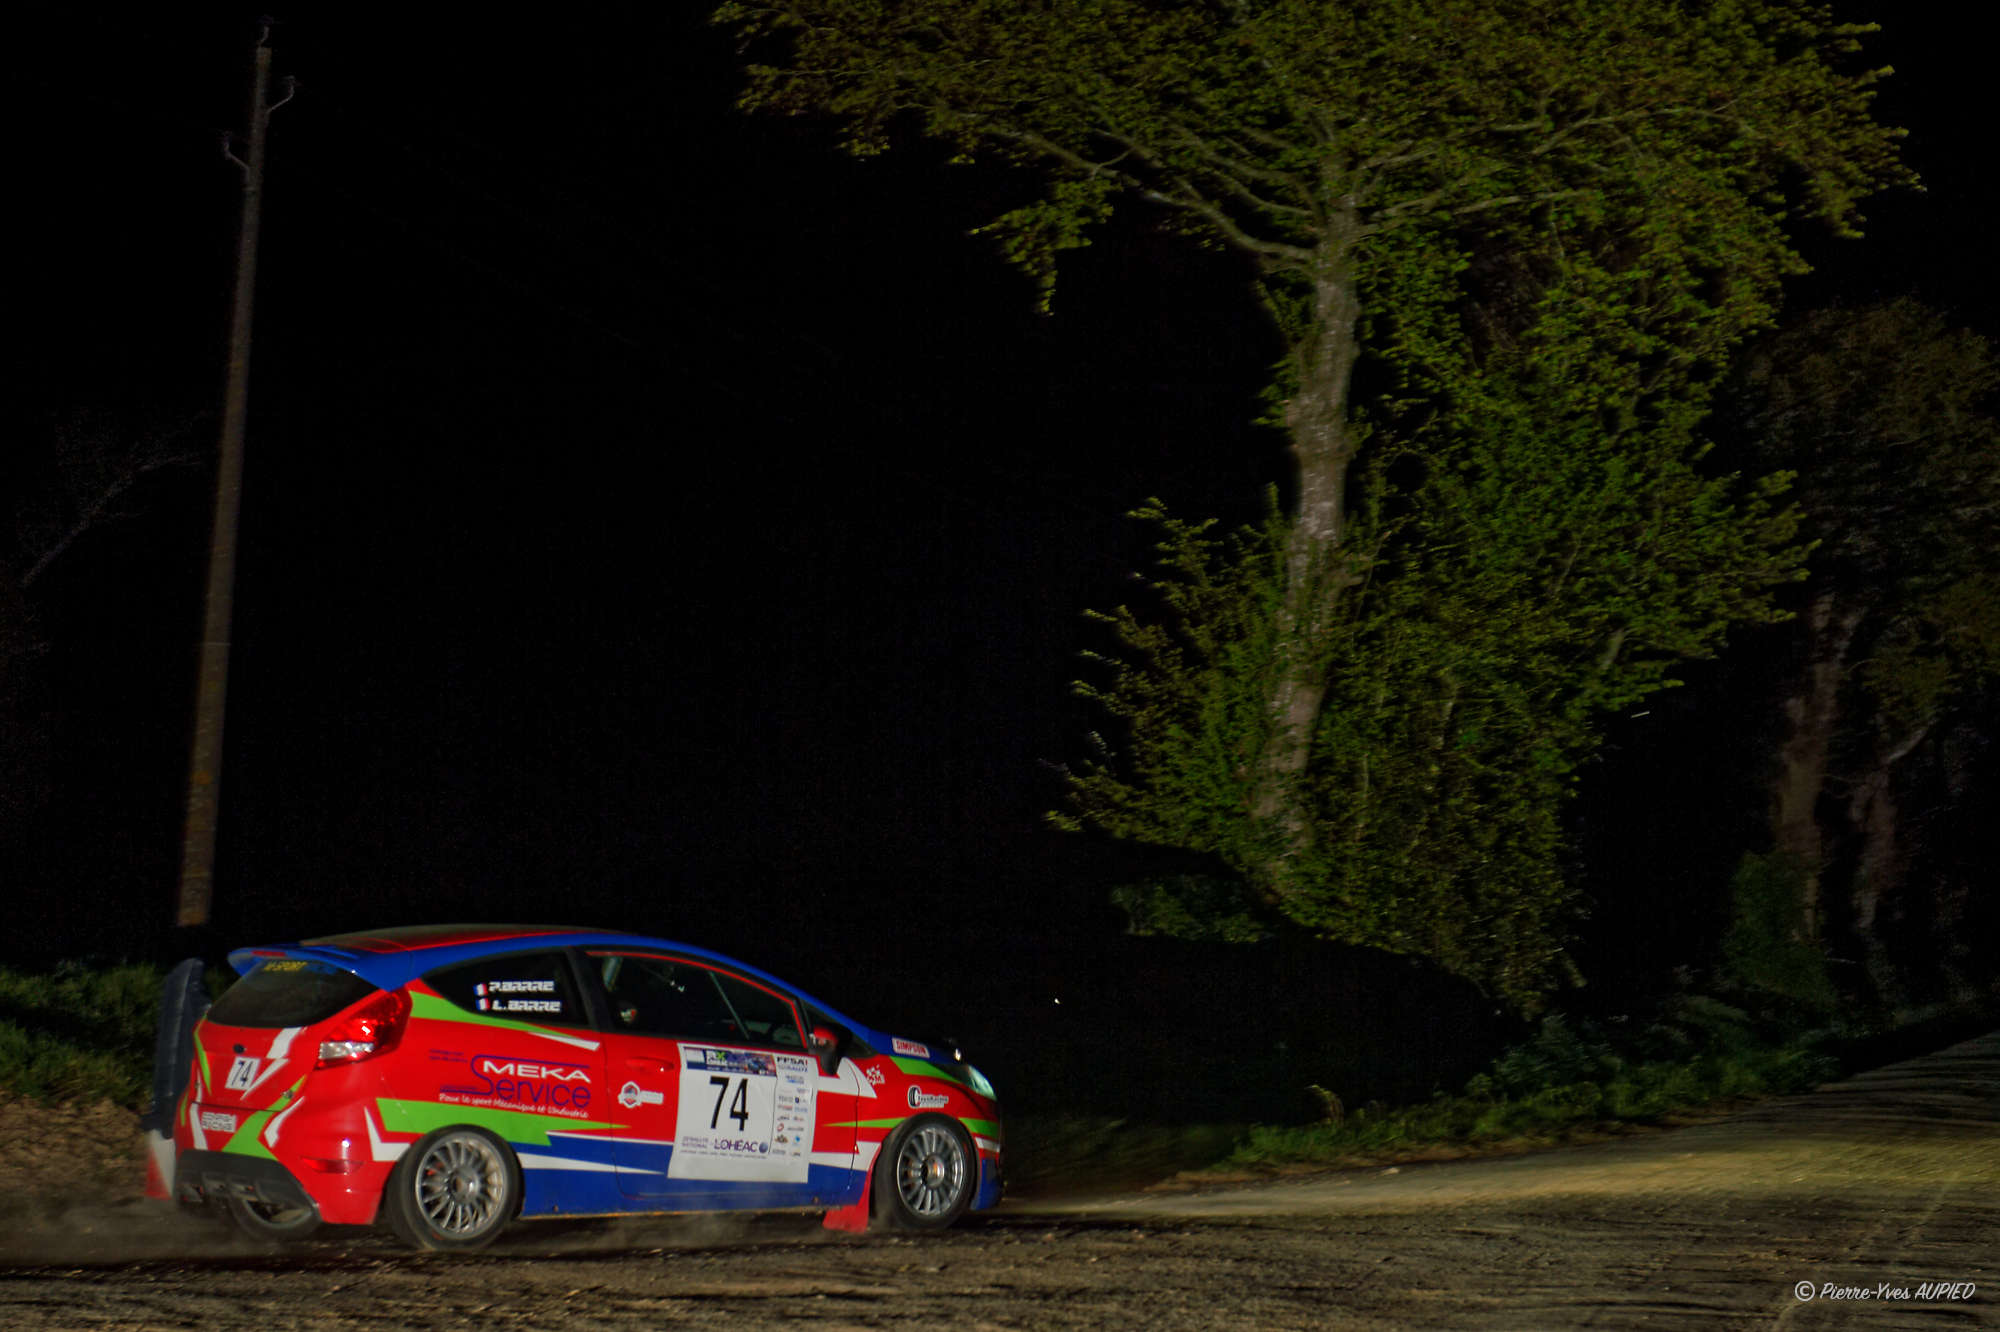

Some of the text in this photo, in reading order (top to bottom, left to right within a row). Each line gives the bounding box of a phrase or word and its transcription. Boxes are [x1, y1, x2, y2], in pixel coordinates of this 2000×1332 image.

[231, 1060, 253, 1087] 74
[483, 1060, 591, 1083] MEKA
[709, 1075, 749, 1131] 74
